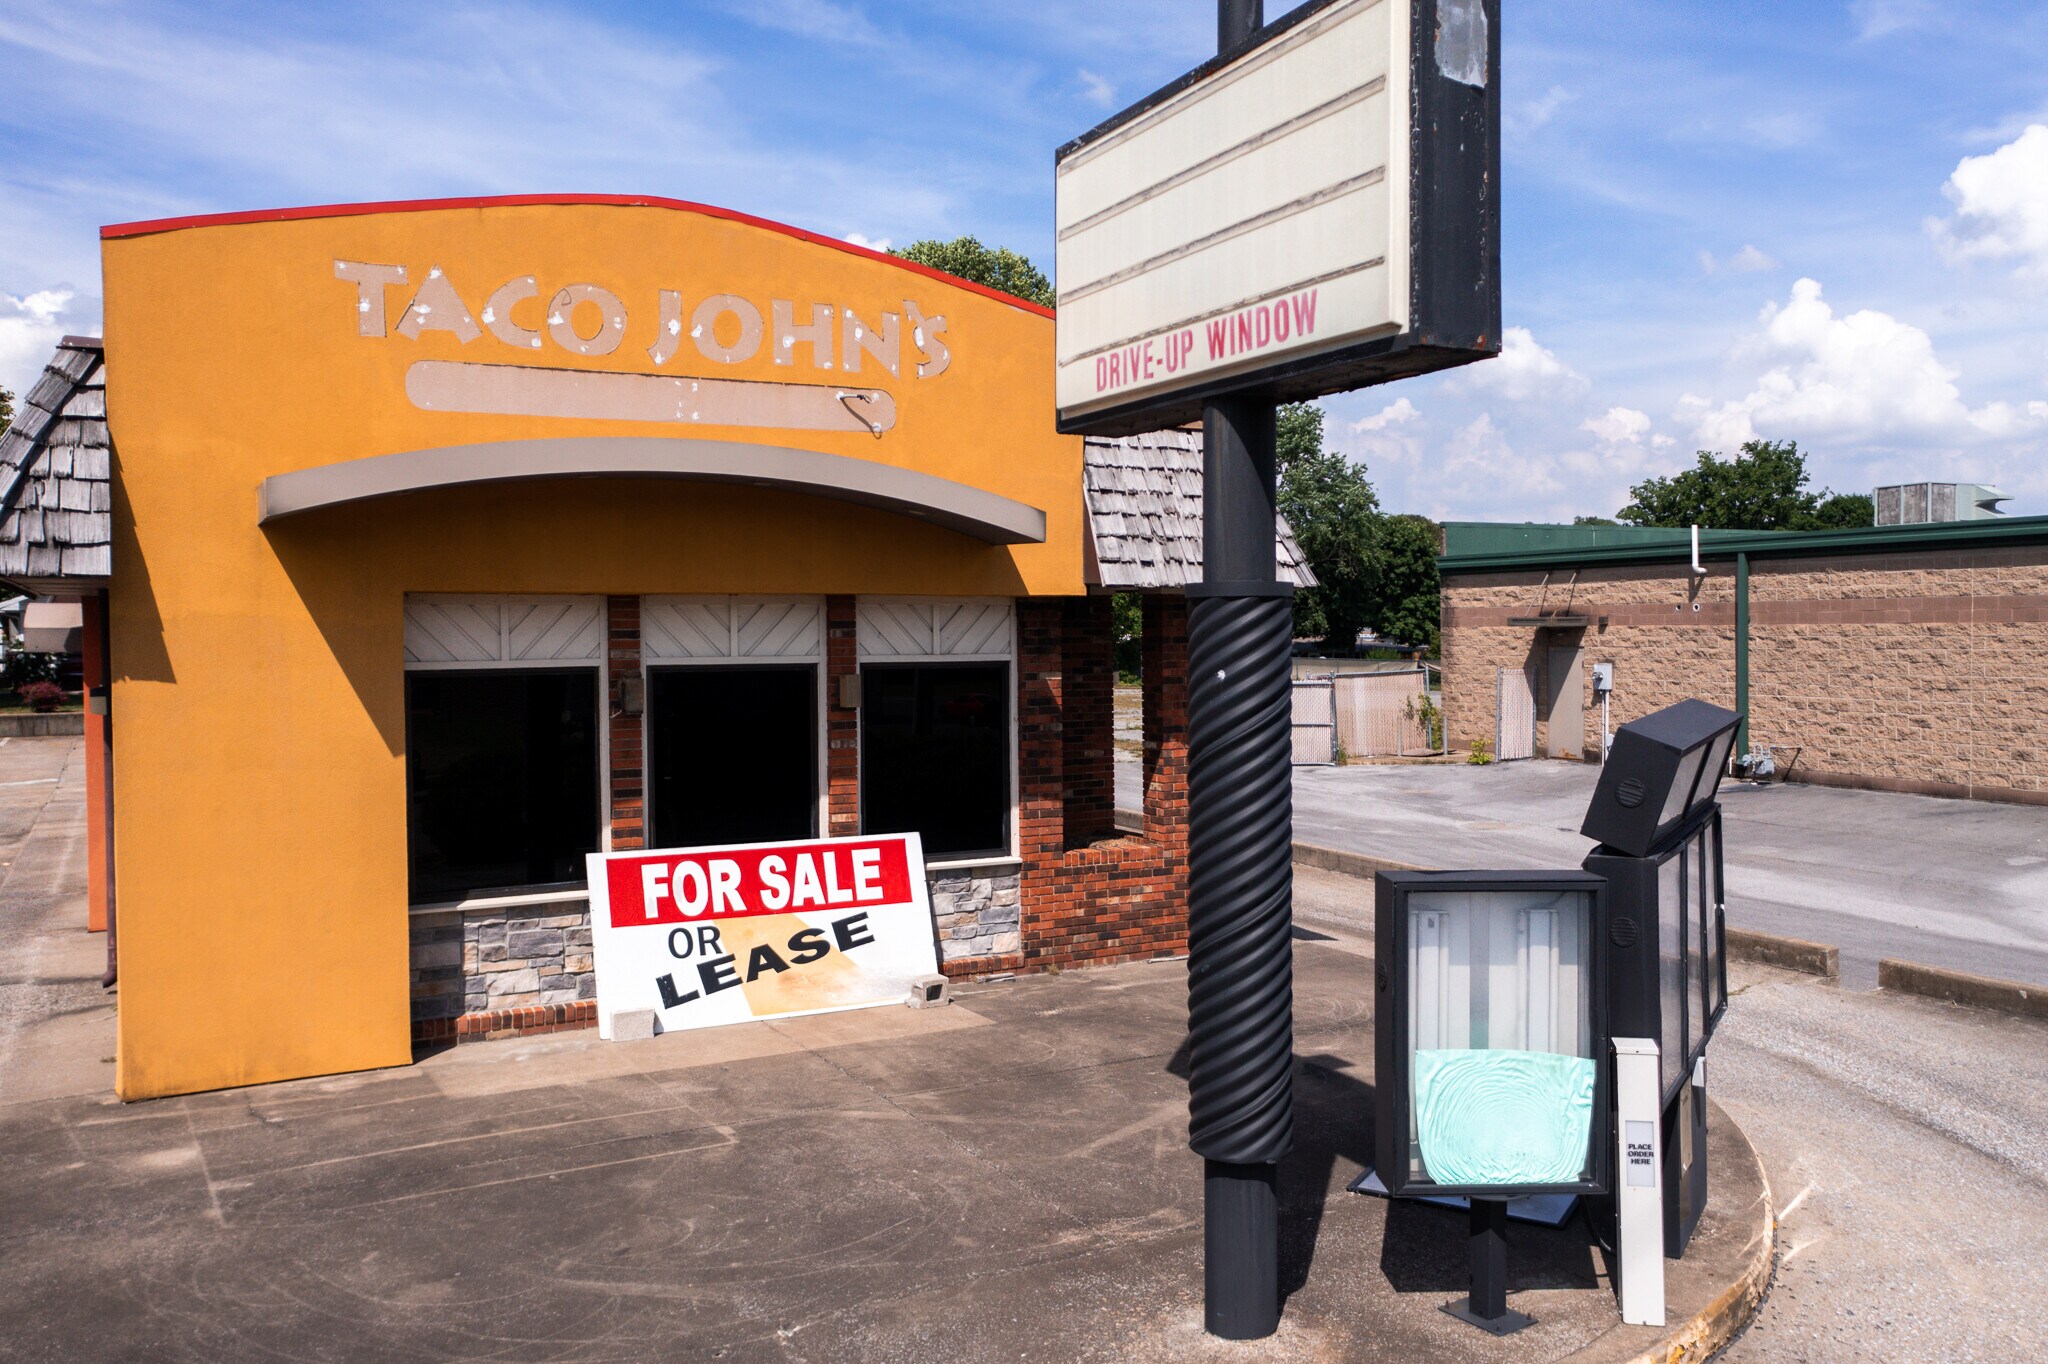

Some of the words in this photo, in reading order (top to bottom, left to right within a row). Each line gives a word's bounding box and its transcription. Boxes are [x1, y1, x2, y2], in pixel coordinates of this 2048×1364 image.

[334, 259, 628, 356] TACO
[1096, 329, 1193, 393] DRIVE-UP
[1206, 289, 1318, 361] WINDOW
[641, 858, 747, 919] FOR
[758, 848, 884, 911] SALE
[655, 911, 875, 1010] LEASE
[668, 925, 723, 960] OR
